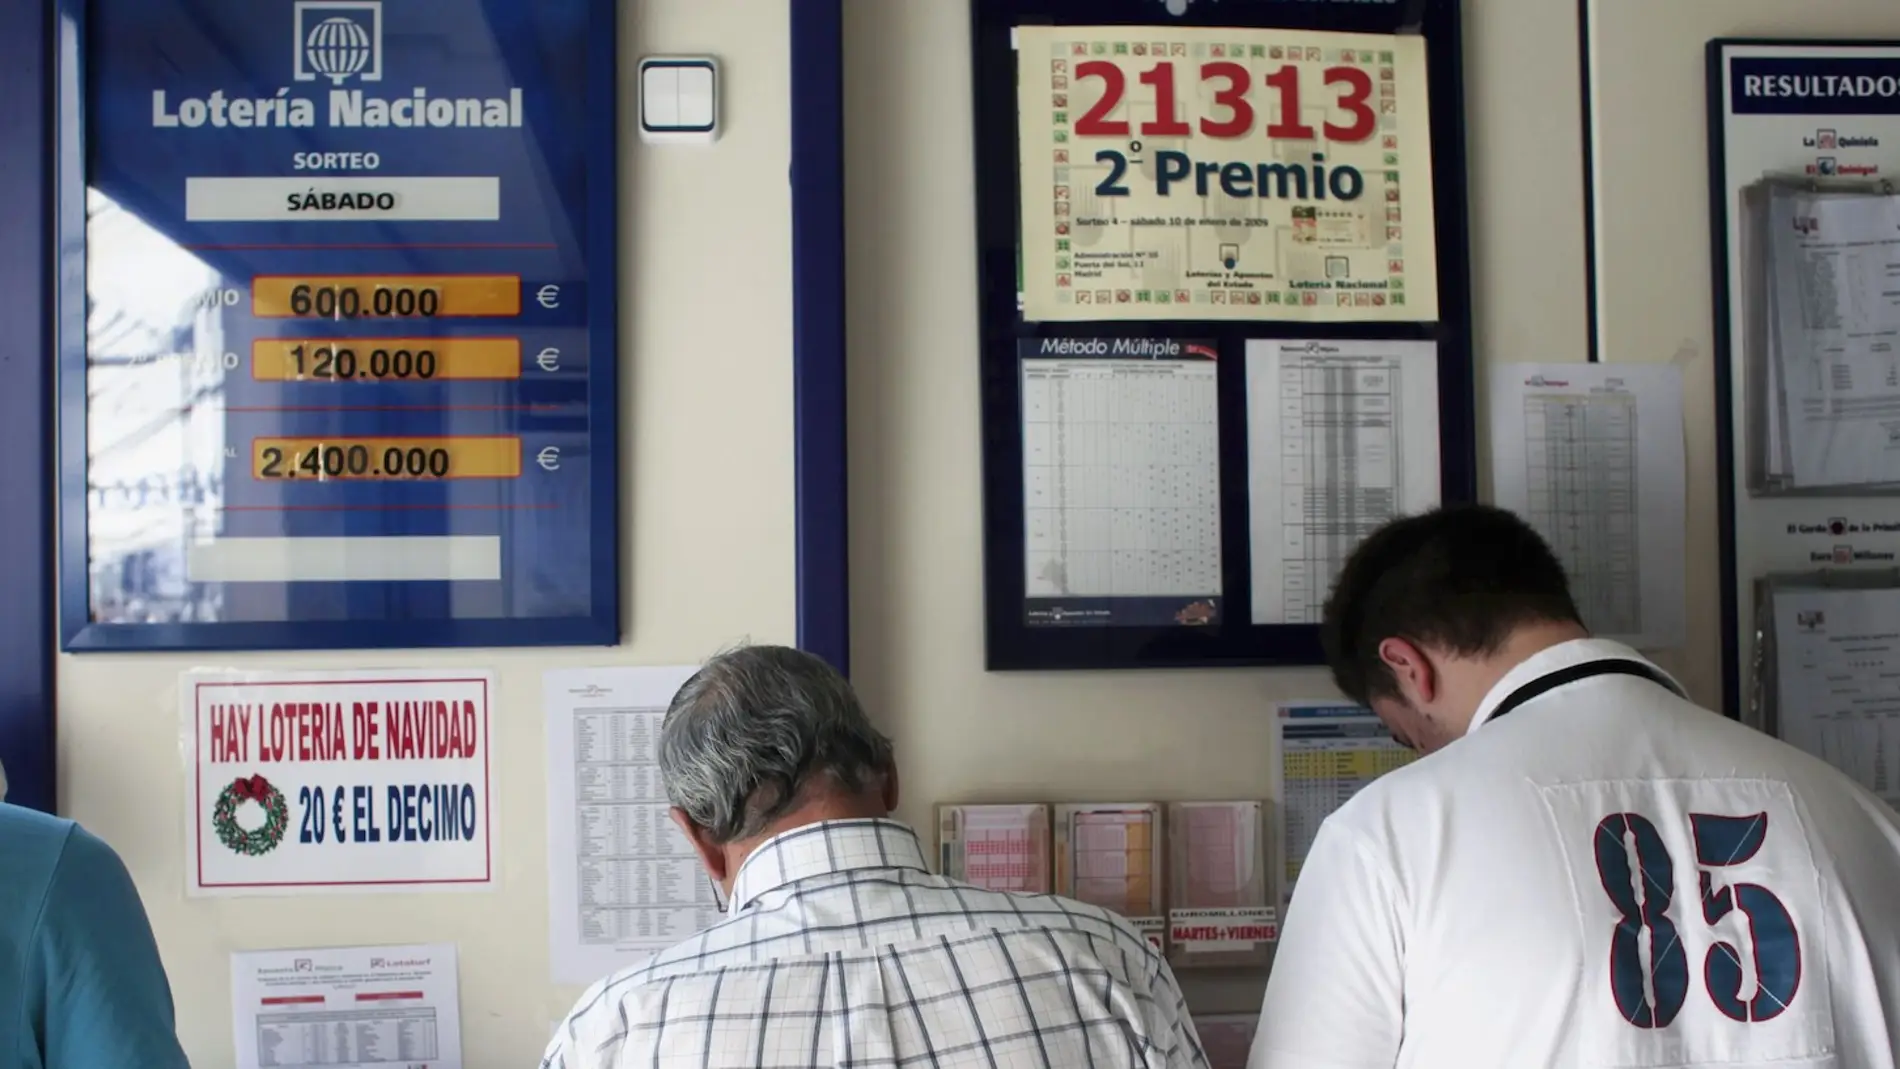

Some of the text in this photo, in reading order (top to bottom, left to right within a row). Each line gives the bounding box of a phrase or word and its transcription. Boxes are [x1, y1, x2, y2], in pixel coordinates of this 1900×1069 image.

[1074, 60, 1377, 142] 21313
[1744, 75, 1900, 97] RESULTADO
[152, 87, 522, 127] Lotería Nacional
[293, 153, 379, 170] SORTEO
[1155, 152, 1364, 201] Premio
[287, 187, 395, 211] SÁBADO
[1076, 217, 1109, 227] Sorteo
[1130, 217, 1166, 227] sábado
[1169, 217, 1182, 227] 10
[1184, 217, 1196, 227] de
[1198, 218, 1227, 228] enero
[1229, 217, 1242, 227] de
[1244, 217, 1269, 227] 2009
[290, 284, 561, 318] 600.000 €
[1335, 280, 1388, 289] Nacional
[290, 345, 561, 379] 120.000 €
[1041, 337, 1181, 360] Método Múltiple
[261, 445, 449, 478] 2.400.000
[536, 446, 561, 471] €
[210, 700, 477, 763] HAY LOTERIA DE NAVIDAD
[299, 783, 476, 844] 20 € EL DECIMO
[1171, 909, 1275, 918] EUROMILLONES
[1594, 811, 1801, 1029] 85
